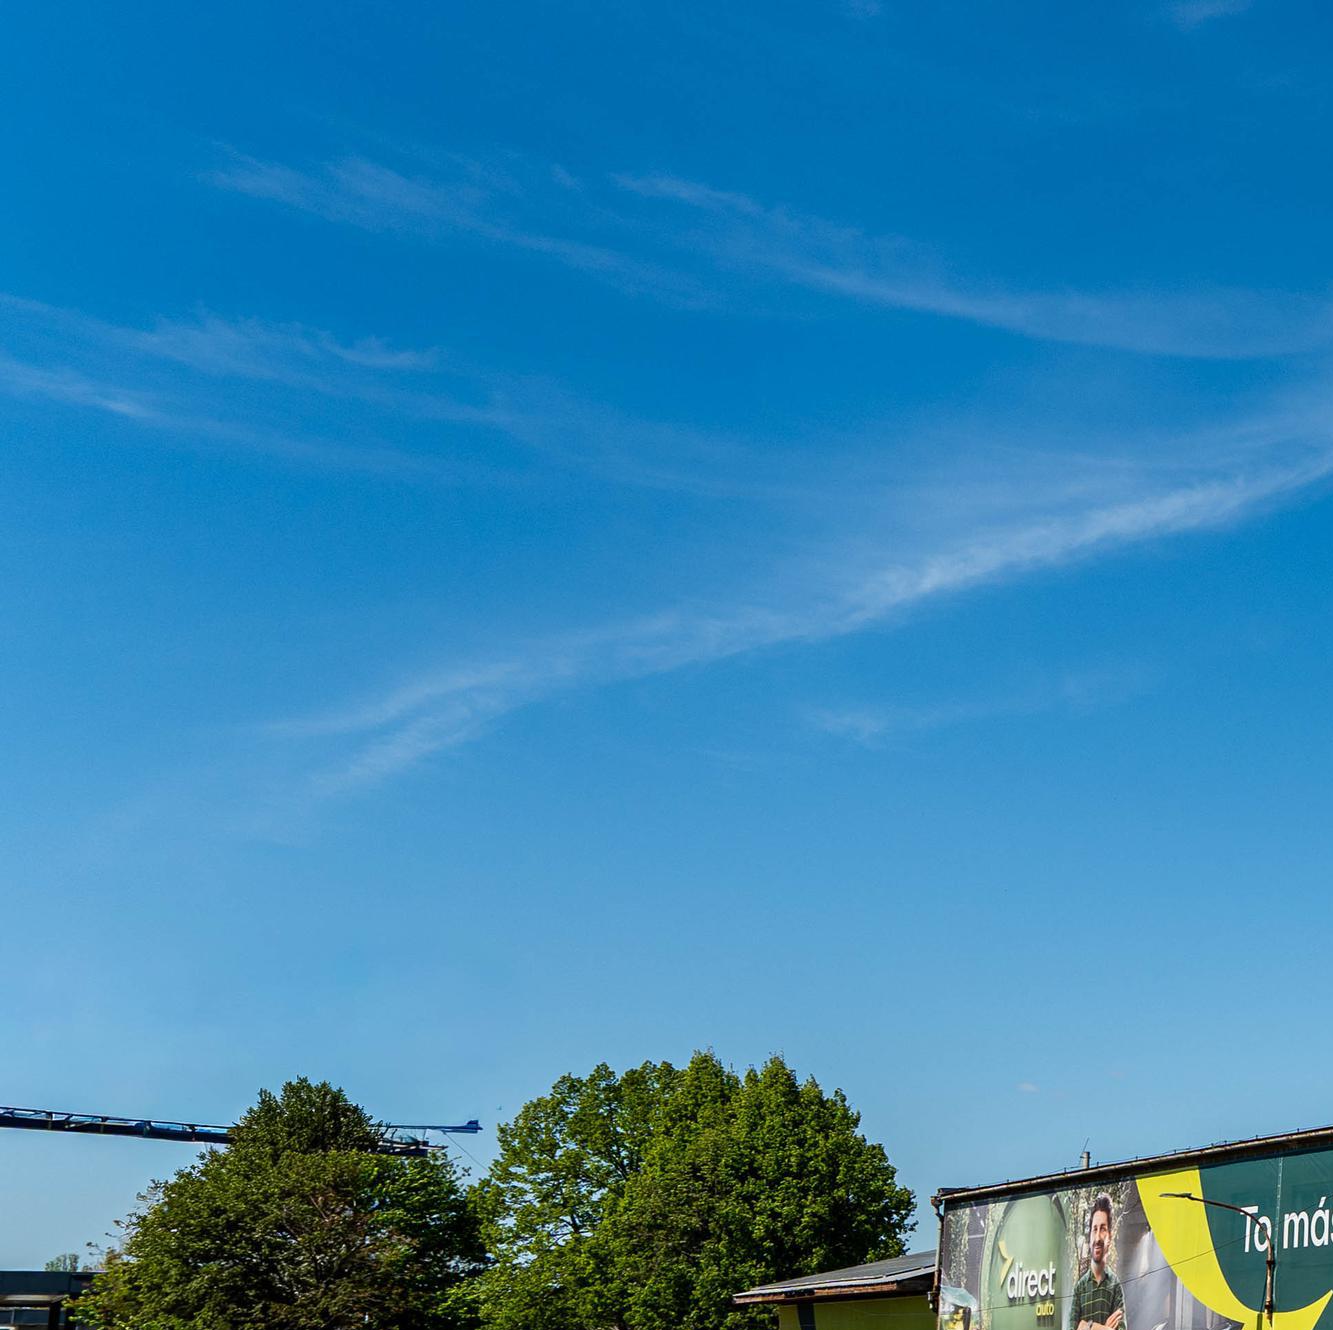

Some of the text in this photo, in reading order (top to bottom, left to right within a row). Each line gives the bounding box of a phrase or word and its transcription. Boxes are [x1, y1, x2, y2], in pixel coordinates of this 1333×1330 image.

[1240, 1205, 1271, 1252] To
[1007, 1261, 1057, 1299] direct
[1036, 1300, 1055, 1316] auto
